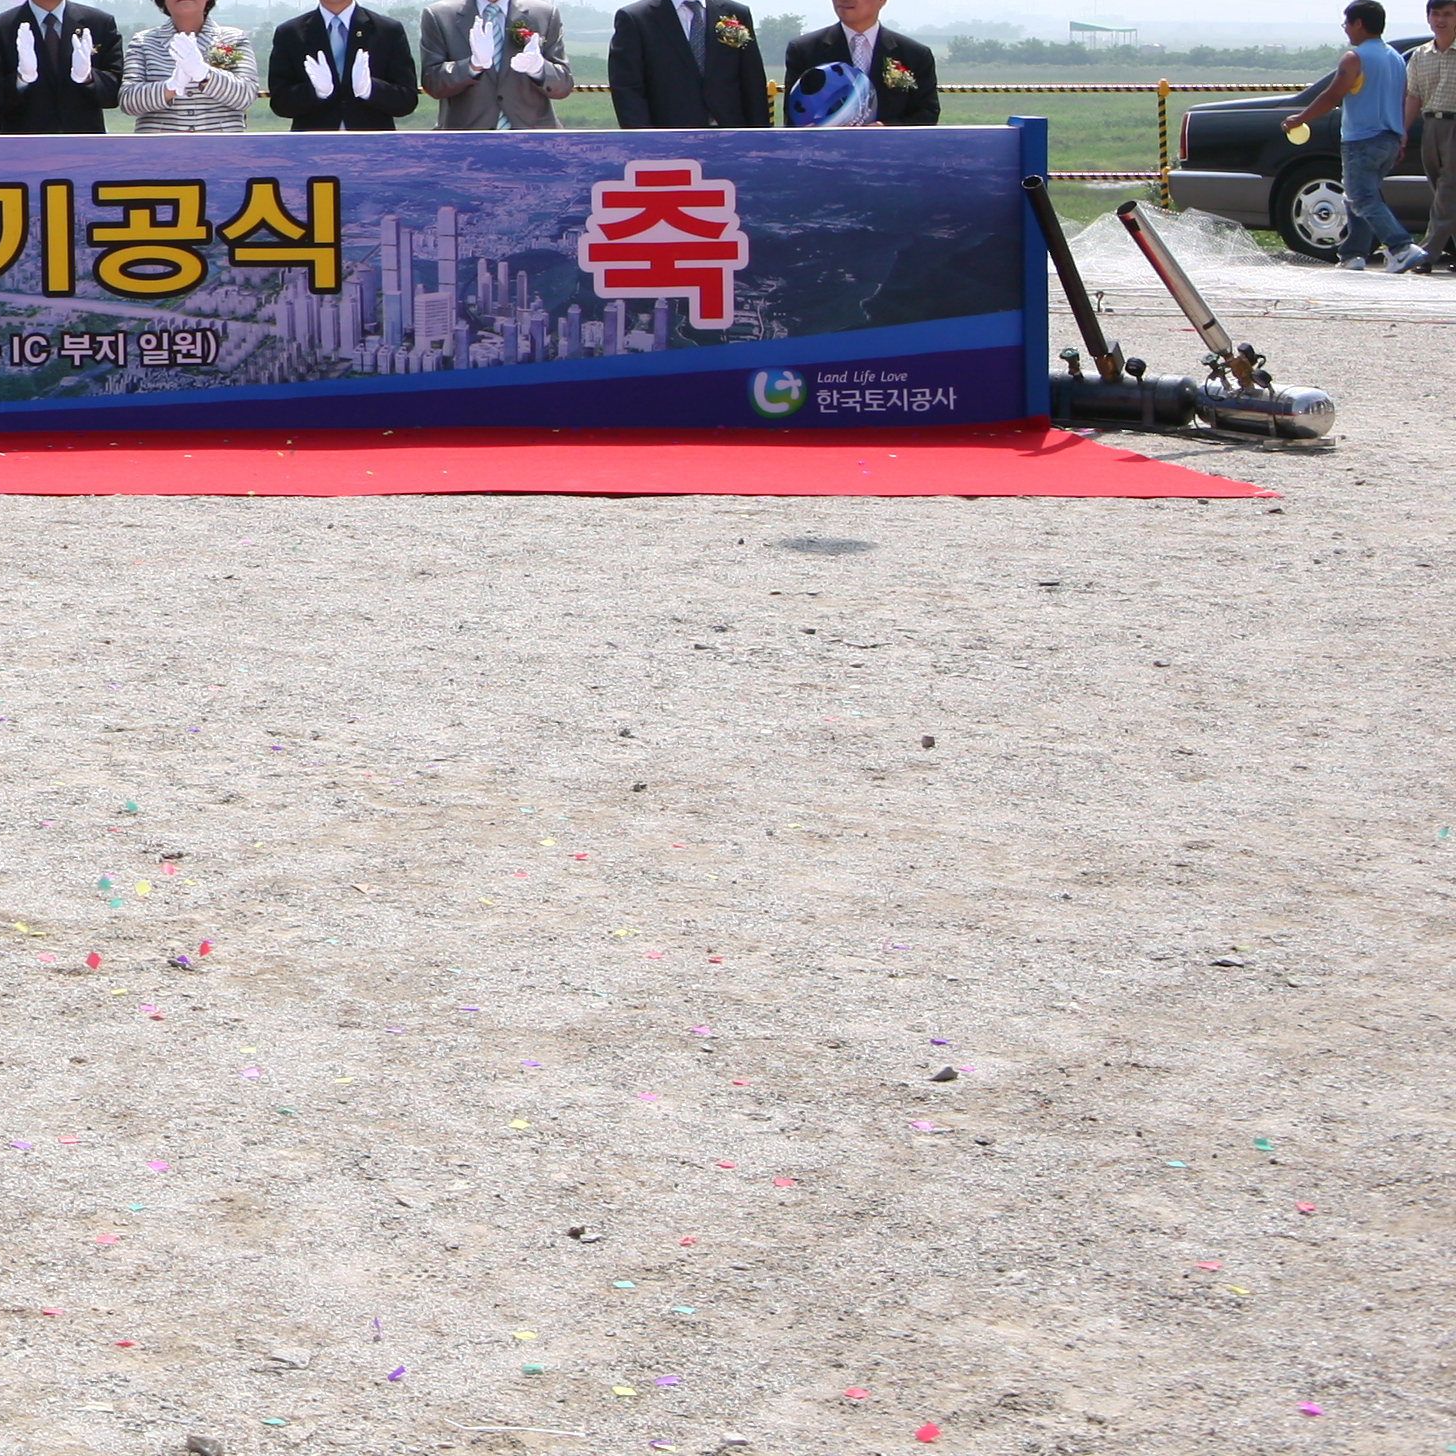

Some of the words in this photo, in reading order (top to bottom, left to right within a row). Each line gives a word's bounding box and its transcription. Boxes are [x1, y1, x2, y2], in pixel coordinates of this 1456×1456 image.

[578, 159, 749, 330] 축
[10, 333, 50, 367] IC
[60, 332, 128, 367] 부지
[138, 330, 220, 367] 일원)
[817, 370, 848, 384] Land
[853, 370, 876, 386] Life
[880, 370, 909, 383] Love
[816, 386, 958, 413] 한국토지공사
